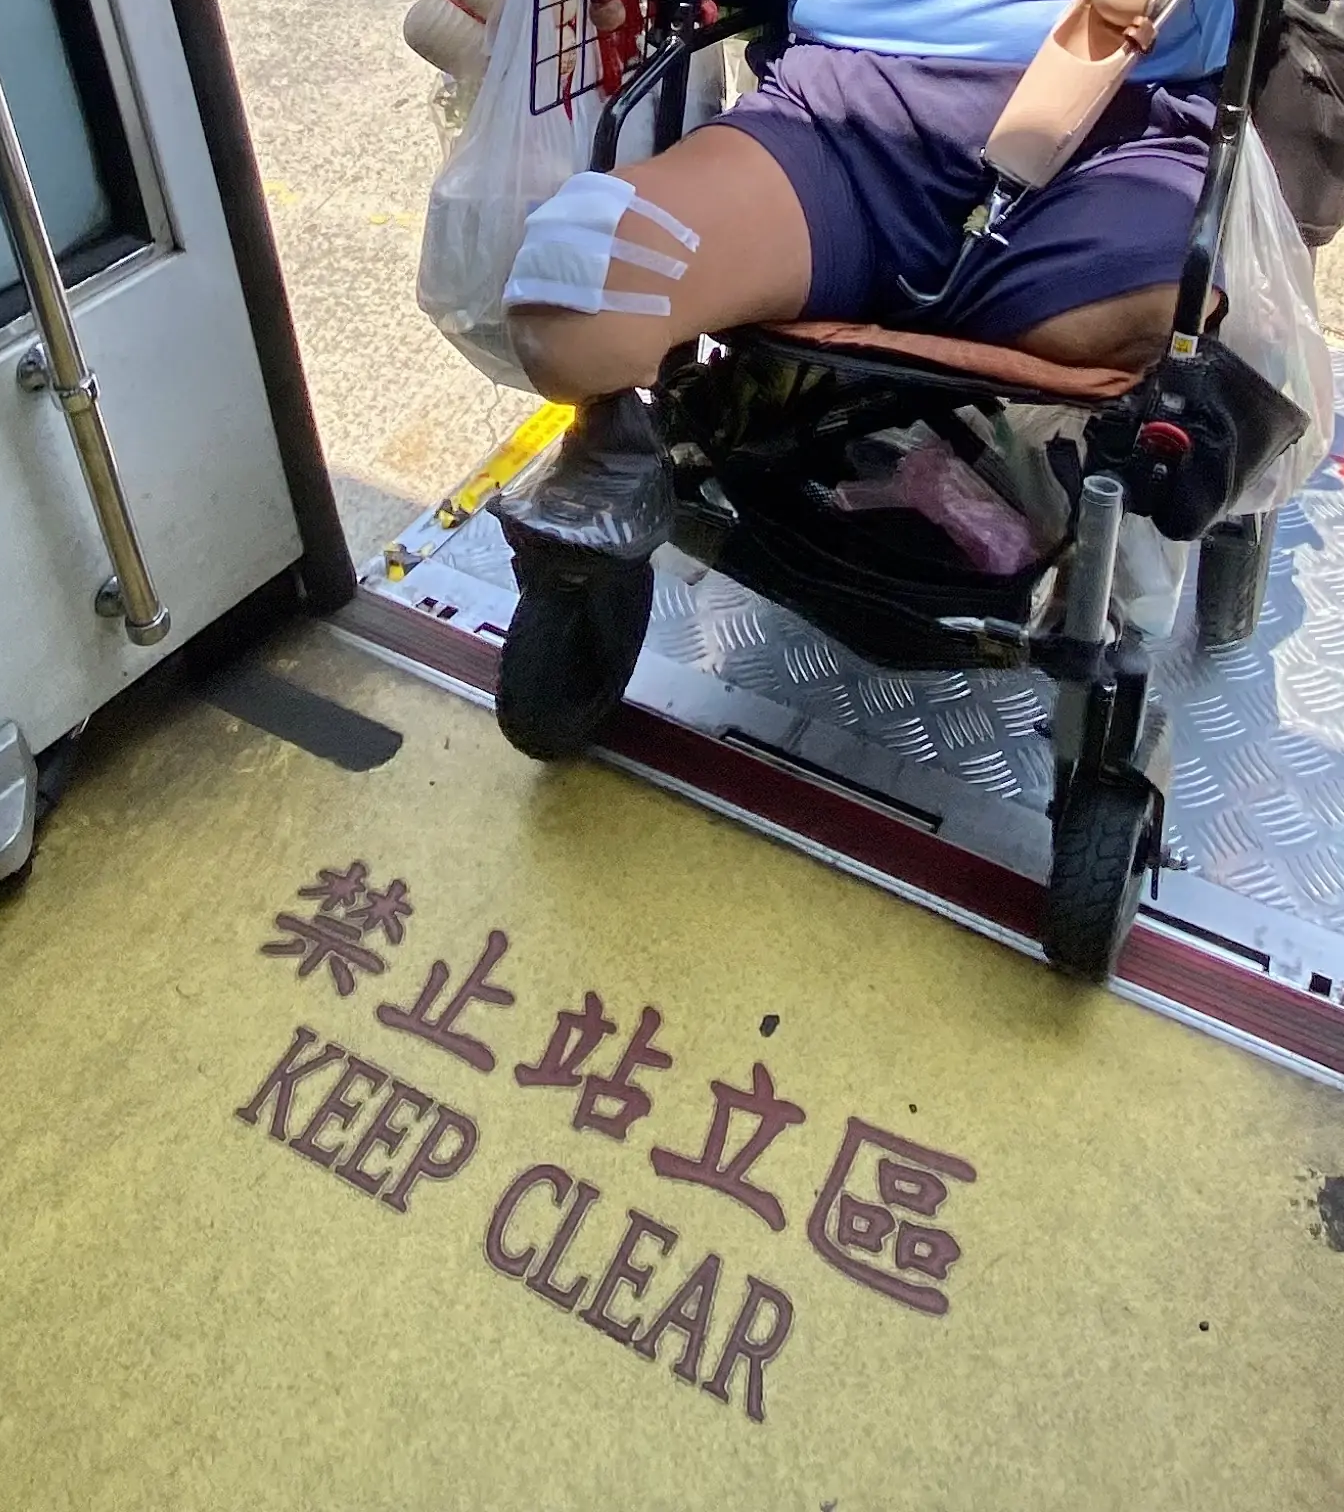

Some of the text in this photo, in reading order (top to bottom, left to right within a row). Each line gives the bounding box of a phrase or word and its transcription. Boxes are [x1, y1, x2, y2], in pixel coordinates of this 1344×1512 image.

[235, 1025, 795, 1424] KEEP CLEAR
[260, 859, 978, 1316] 禁止站立區
